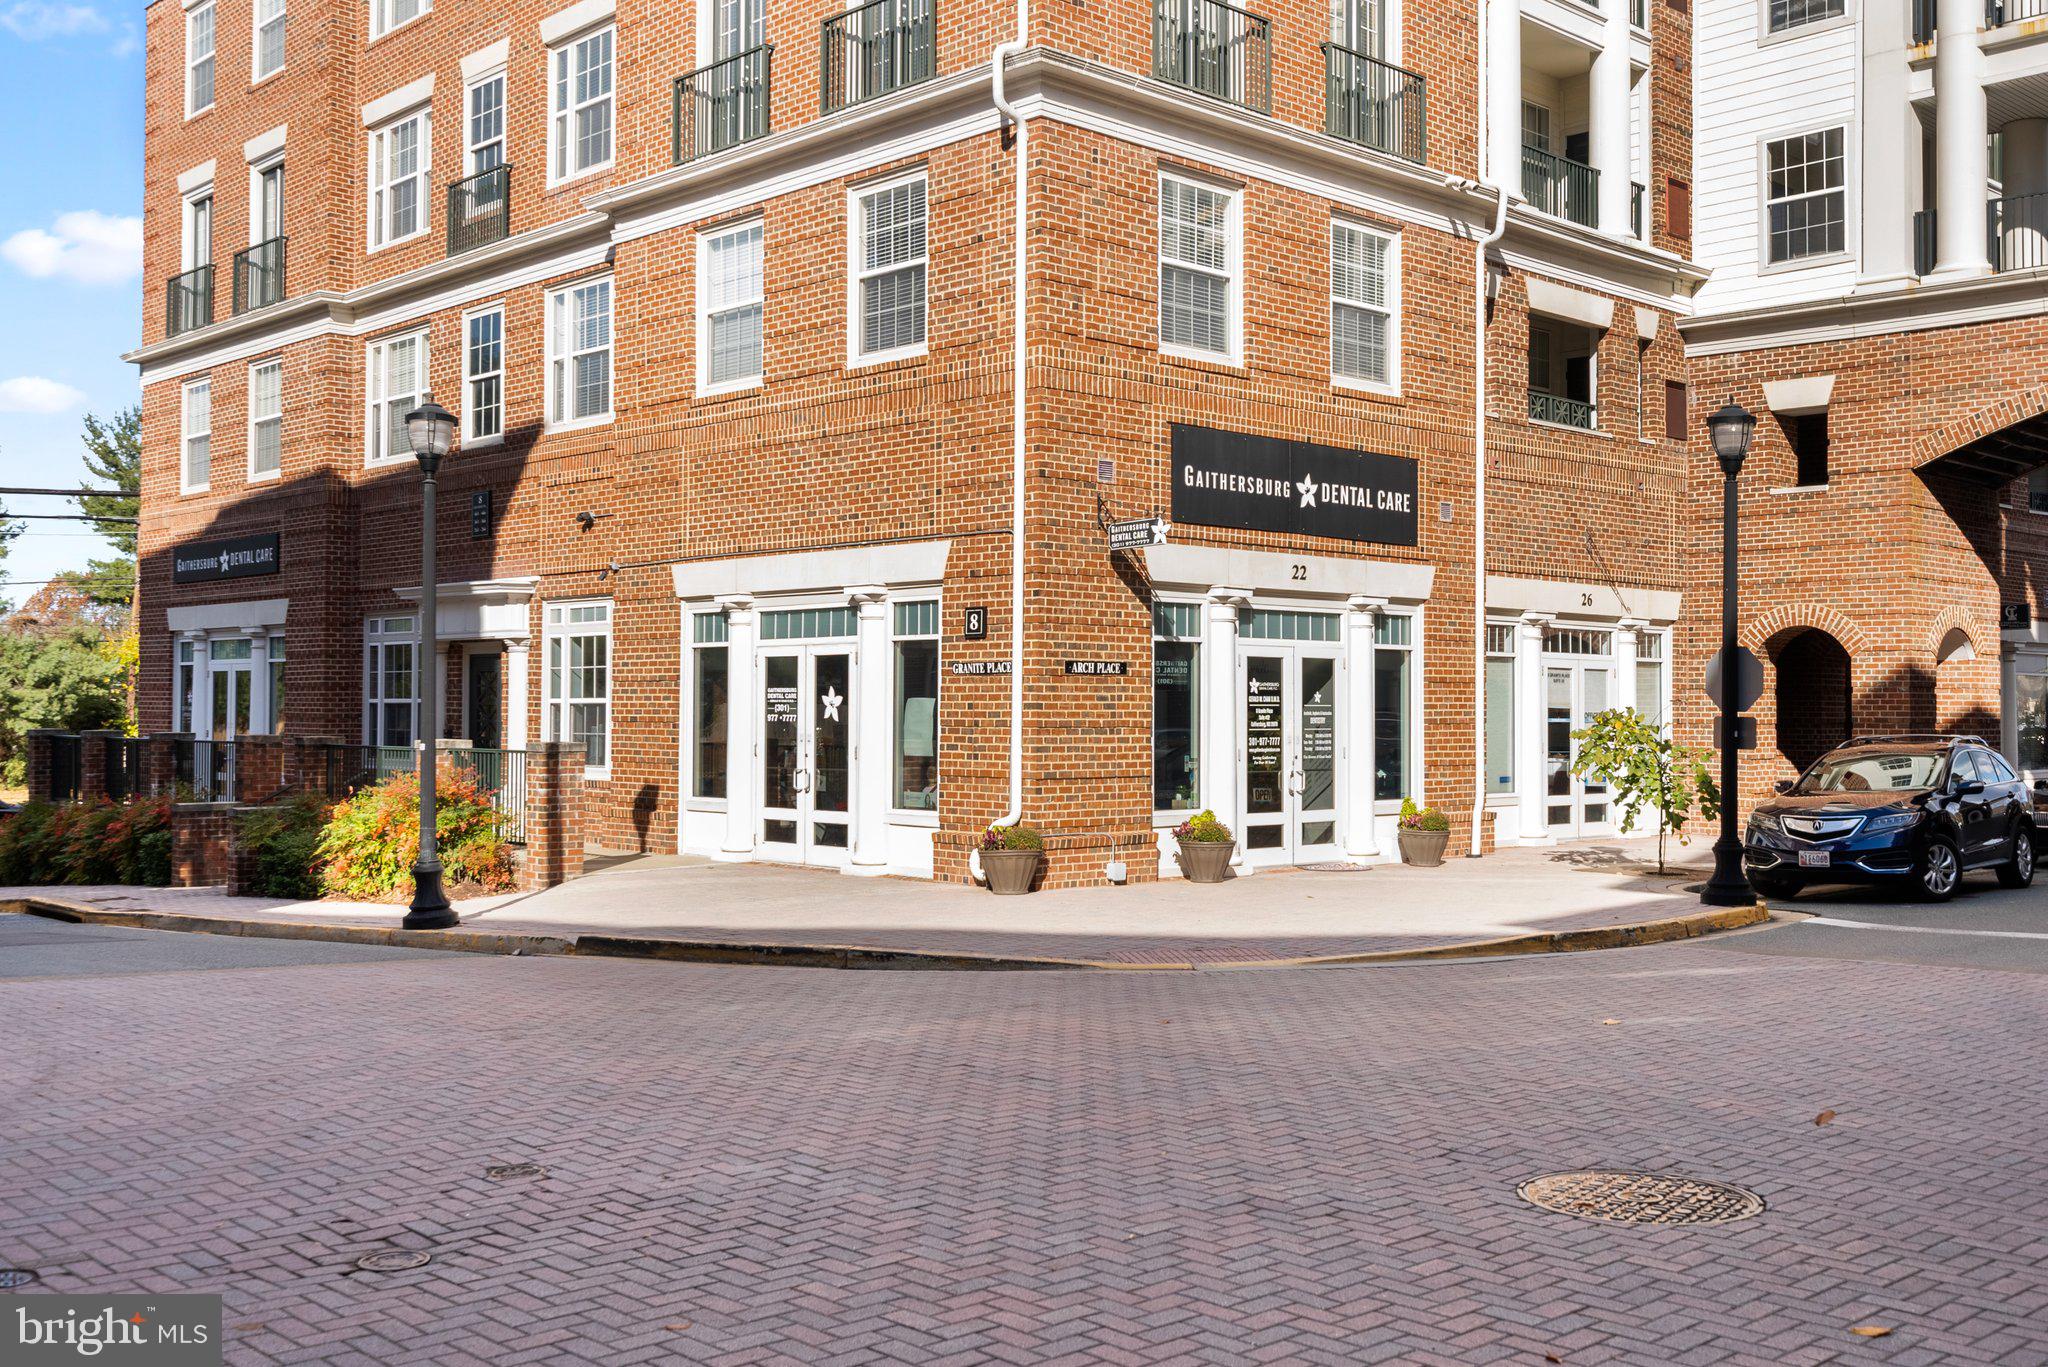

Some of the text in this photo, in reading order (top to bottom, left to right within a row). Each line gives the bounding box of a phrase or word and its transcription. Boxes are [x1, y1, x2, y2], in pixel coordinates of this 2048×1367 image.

[1184, 465, 1411, 513] GAITHERSBURG DENTAL CARE
[1111, 522, 1150, 534] GAITHERSBURG
[1111, 530, 1148, 542] DENTAL CARE
[177, 548, 273, 572] GAITHERSBURG DENTAL CARE
[1291, 564, 1307, 581] 22
[1582, 593, 1593, 607] 26
[970, 613, 979, 631] 8
[953, 661, 1012, 675] GRANITE PLACE
[1072, 662, 1121, 674] ARCH PLACE
[774, 703, 790, 713] (301)
[767, 714, 778, 722] 977
